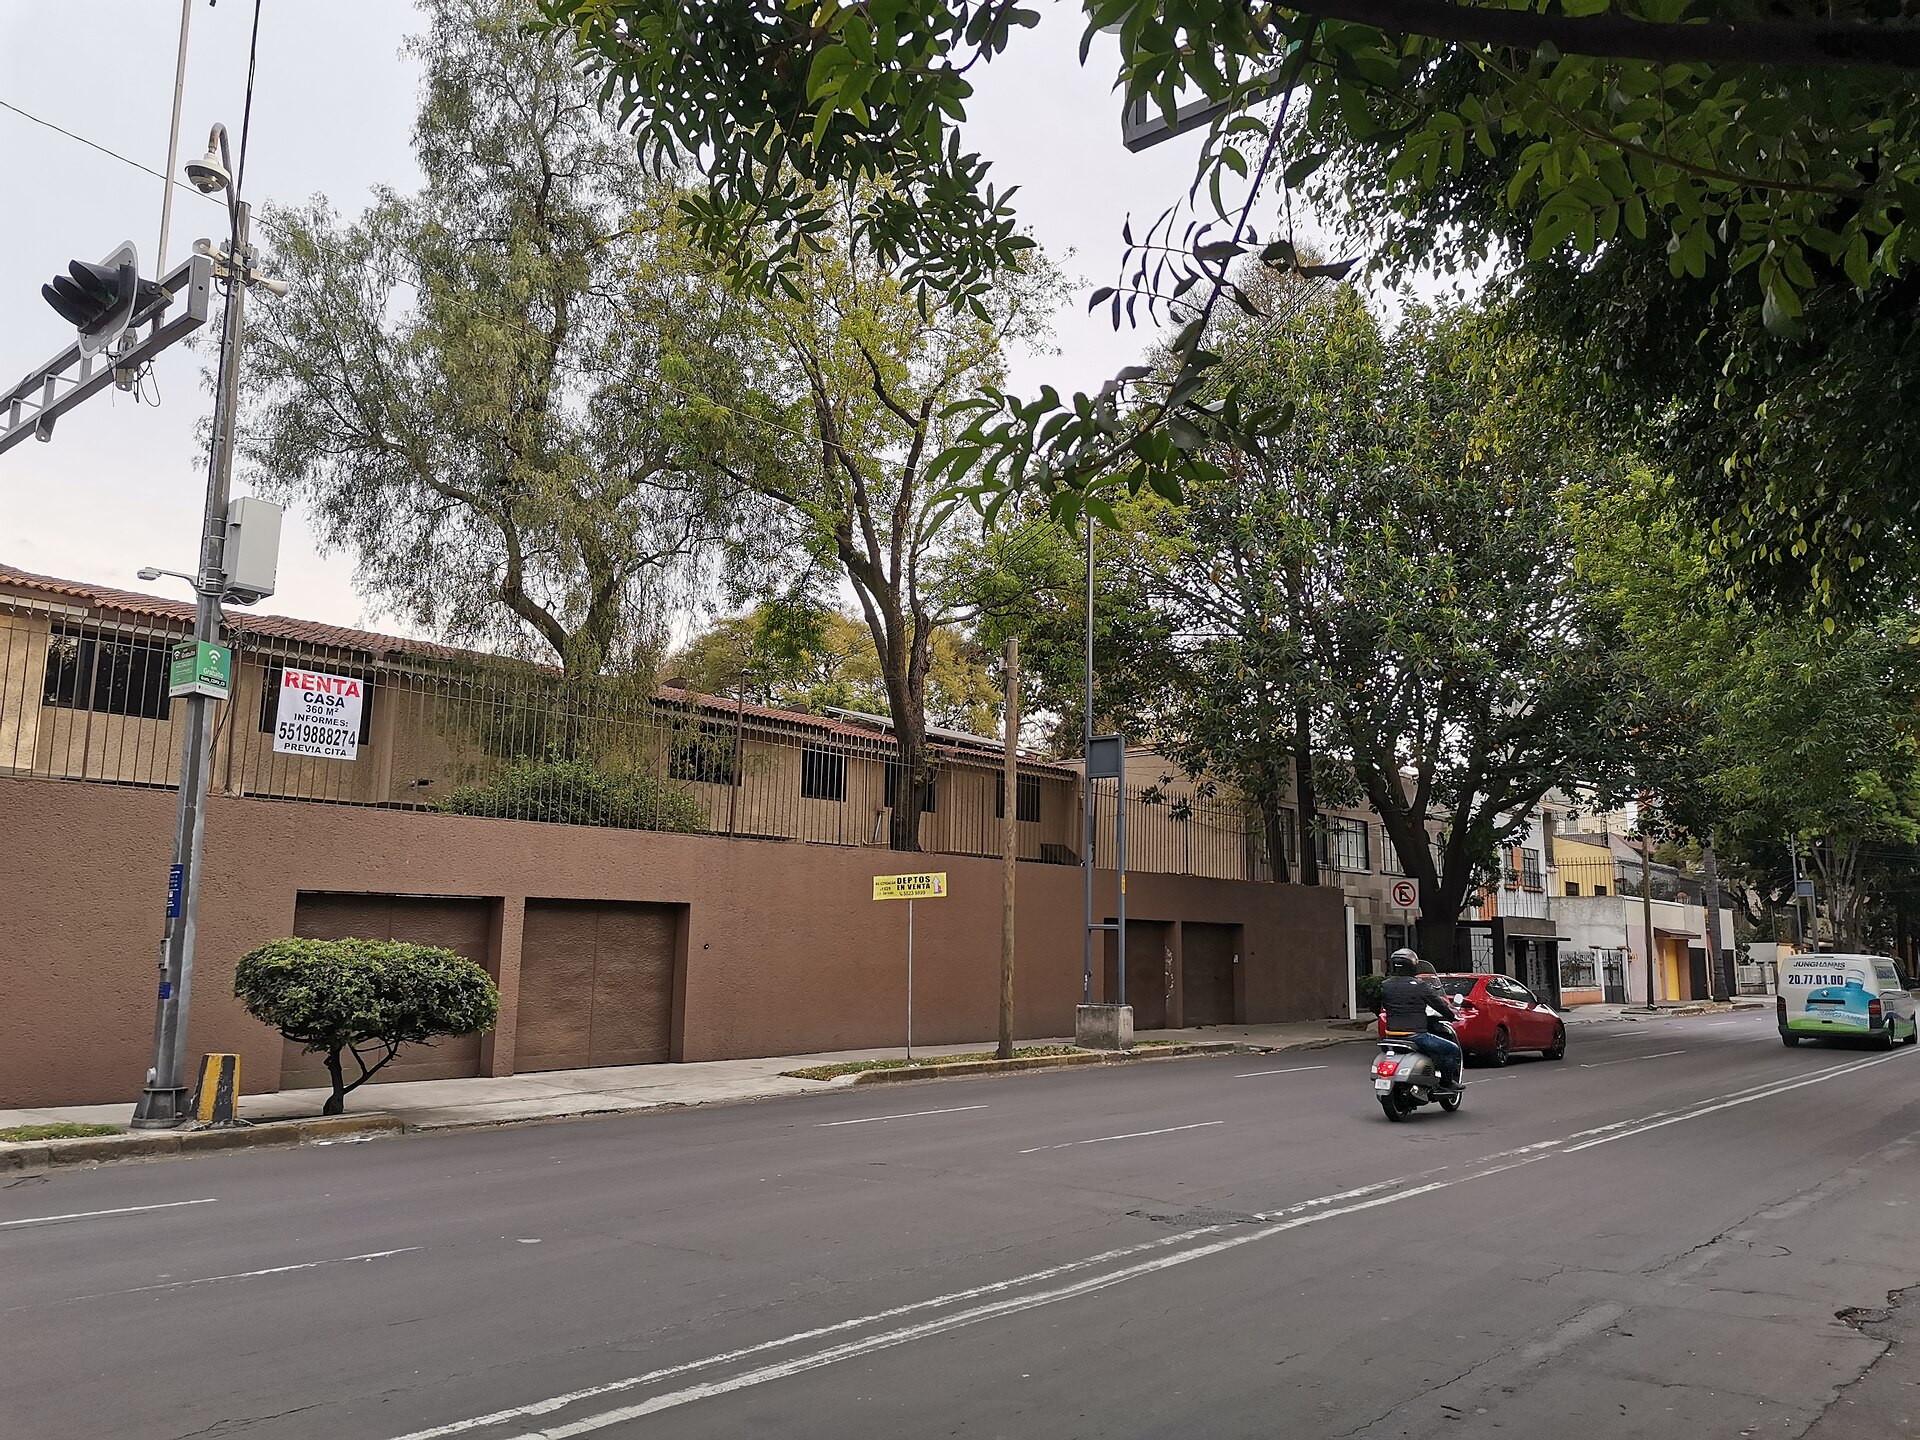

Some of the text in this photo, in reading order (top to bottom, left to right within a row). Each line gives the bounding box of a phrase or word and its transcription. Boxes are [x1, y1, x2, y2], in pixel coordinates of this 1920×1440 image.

[284, 671, 360, 698] RENTA
[303, 692, 345, 708] CASA
[305, 705, 323, 714] 360
[294, 713, 349, 727] INFORMES:
[279, 721, 356, 748] 5519888274
[283, 742, 347, 757] PREVIA CITA
[896, 875, 931, 885] DEPTOS
[1793, 961, 1846, 969] JUNGHANNS
[1788, 974, 1844, 986] 20.77.01.00
